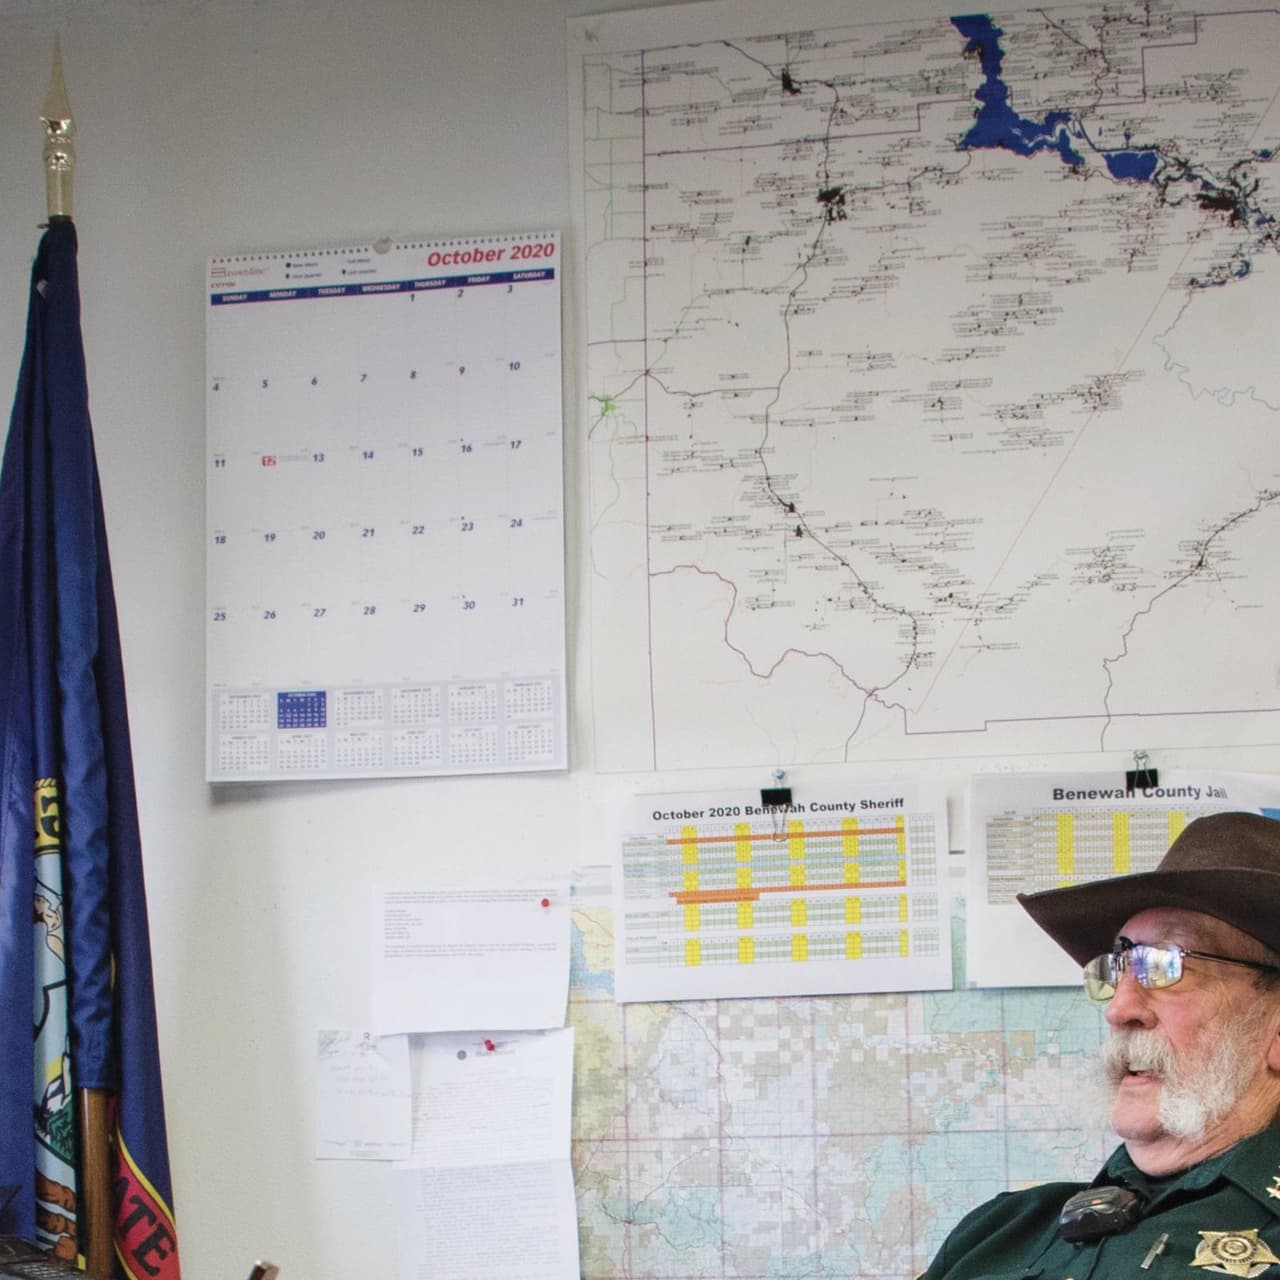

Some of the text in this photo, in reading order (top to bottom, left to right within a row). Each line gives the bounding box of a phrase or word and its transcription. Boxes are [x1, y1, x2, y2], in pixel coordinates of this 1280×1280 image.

[427, 243, 555, 267] October 2020
[222, 271, 546, 302] SUNDAY MONDAY TUESDAY WEDNESDAY THURSDAY FRIDAY SATURDAY
[410, 284, 513, 302] 1 2 3
[212, 361, 521, 392] 4 5 6 7 8 9 10
[214, 439, 522, 468] 11 12 13 14 15 16 17
[215, 518, 523, 545] 18 19 20 21 22 23 24
[213, 597, 525, 622] 25 26 27 28 29 30 31
[1052, 785, 1228, 801] Benewah County Jail
[652, 798, 905, 821] October 2020 Benewah County Sheriff
